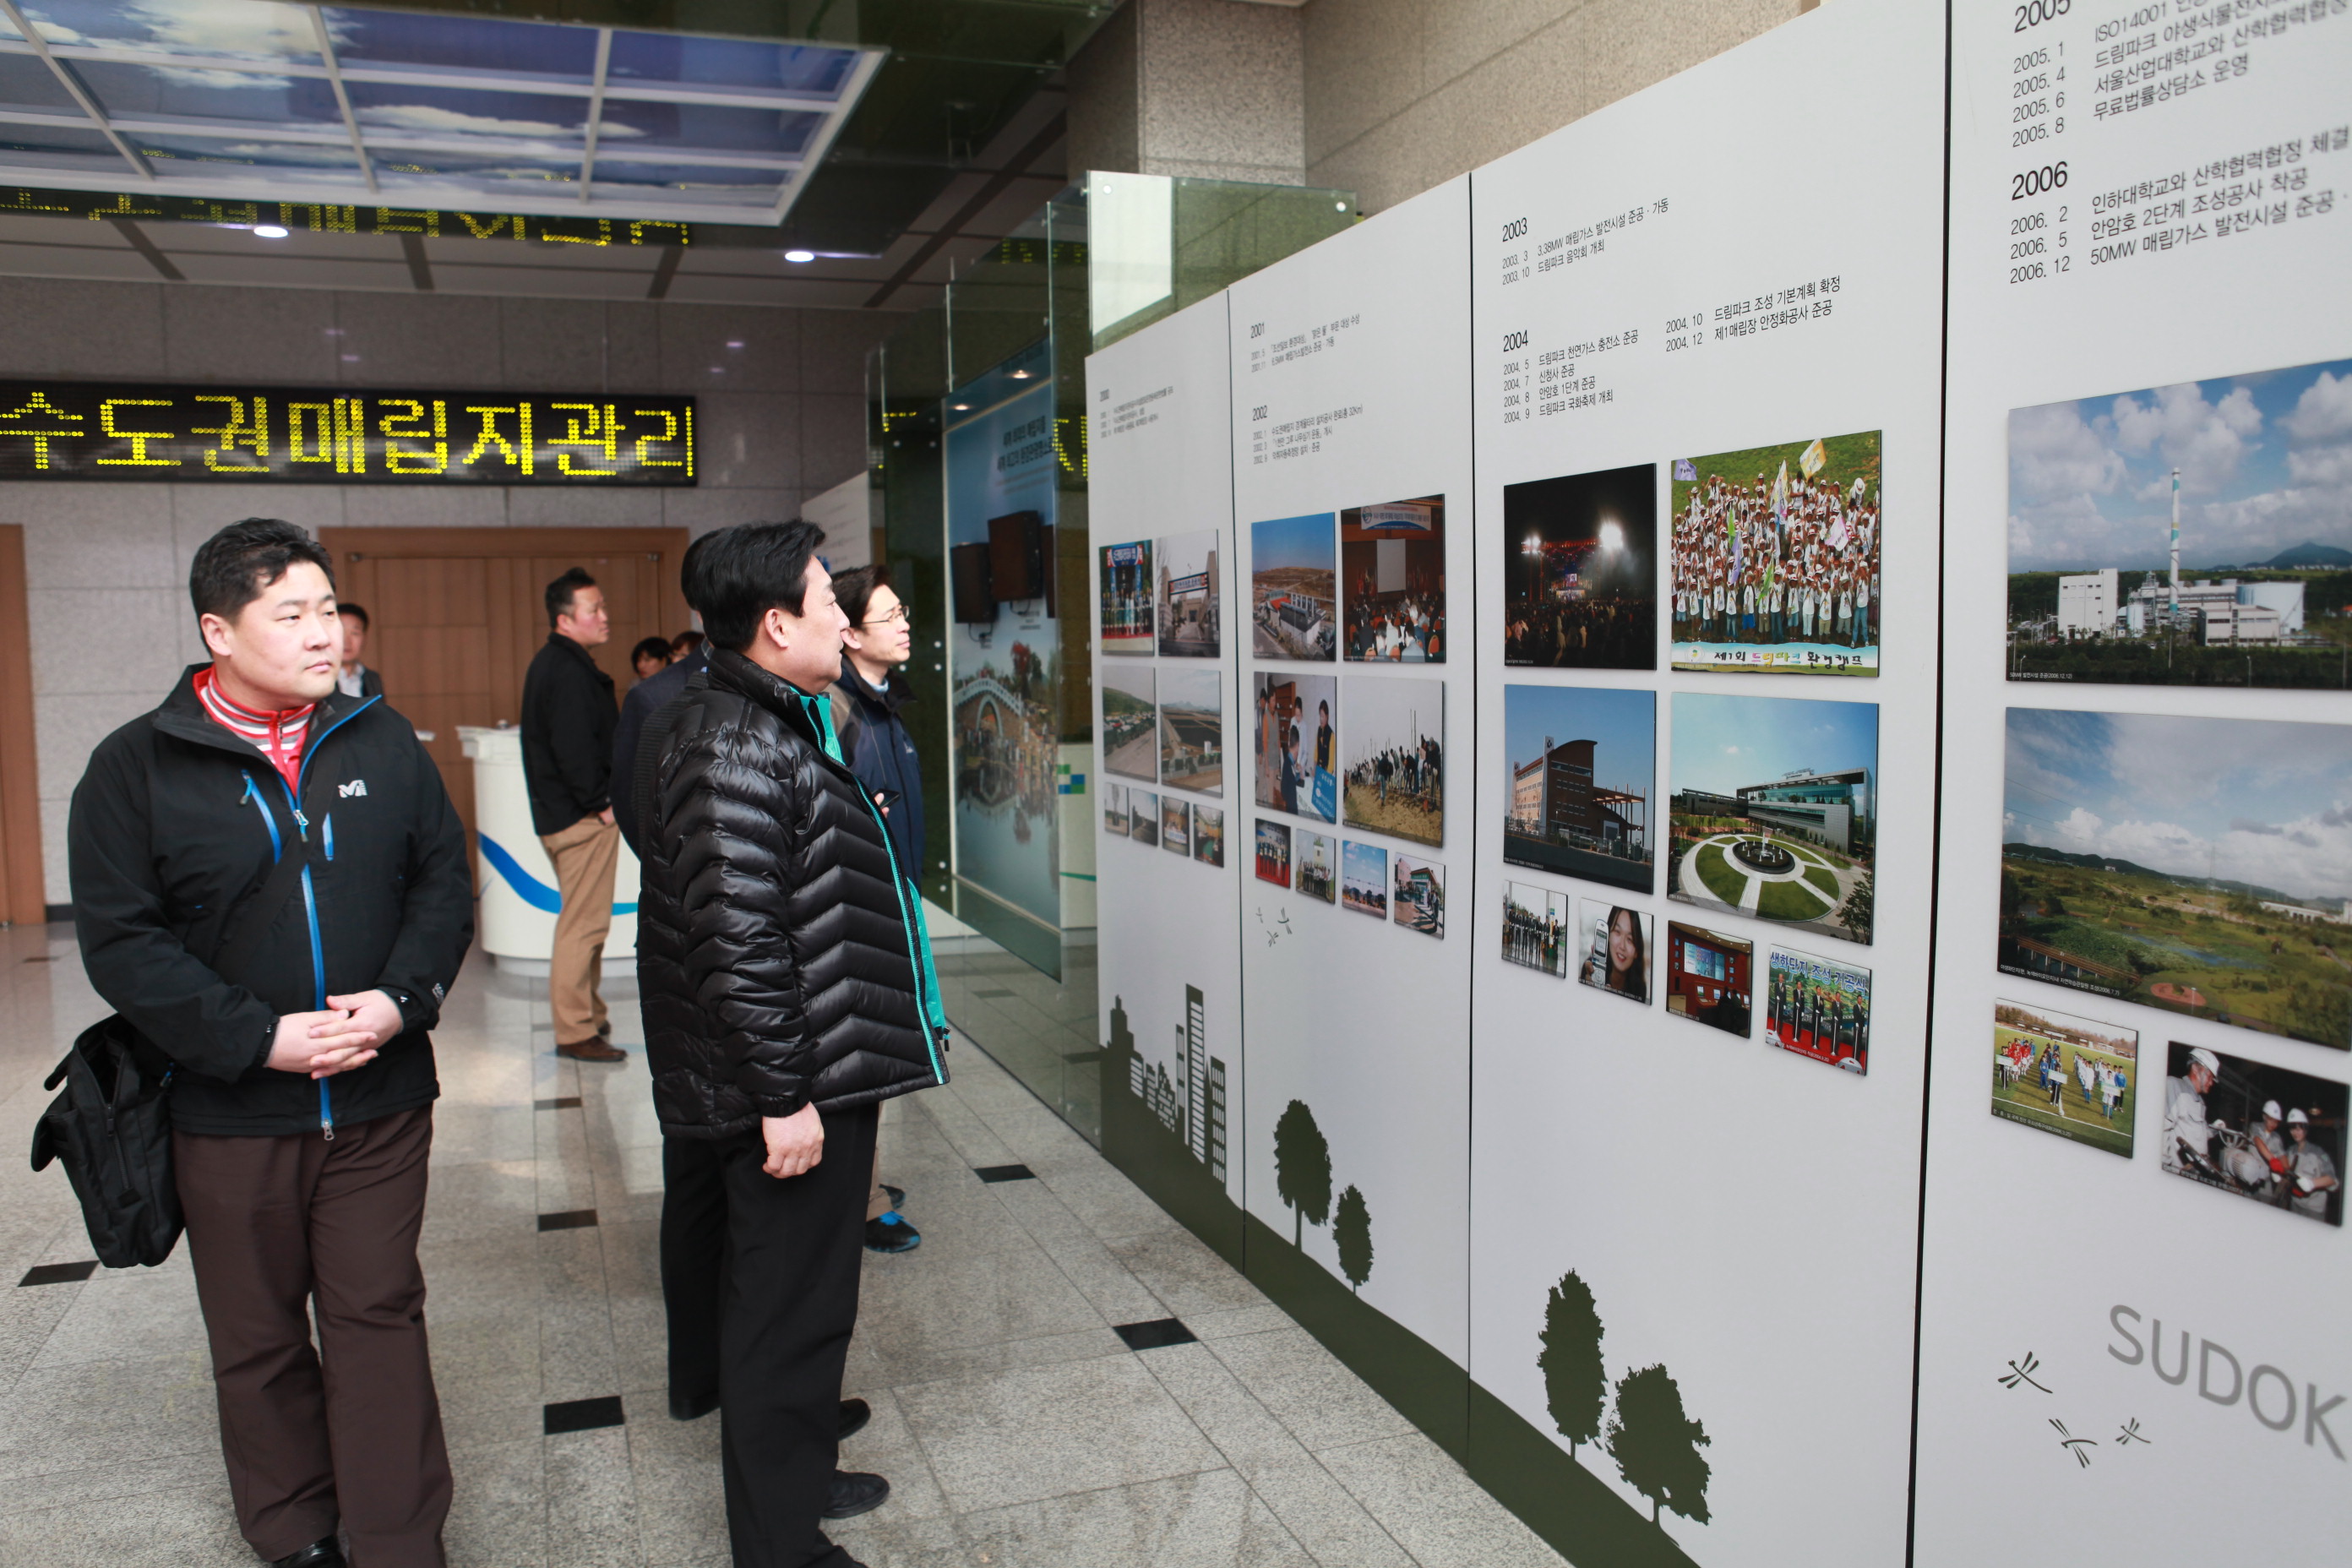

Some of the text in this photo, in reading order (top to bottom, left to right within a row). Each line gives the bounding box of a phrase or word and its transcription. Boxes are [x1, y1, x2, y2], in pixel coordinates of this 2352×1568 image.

[2014, 47, 2050, 74] 2005.
[2059, 41, 2064, 57] 1
[2095, 3, 2167, 42] ISO14001
[2013, 74, 2050, 99] 2005.
[2056, 67, 2065, 82] 4
[2094, 33, 2158, 68] 드림파크
[2013, 99, 2050, 122] 2005.
[2055, 92, 2065, 107] 6
[2094, 34, 2225, 94] 서울산업대학교와
[2012, 52, 2248, 148] 2005. 8 무료법률상담소 운영
[2011, 125, 2350, 236] 2006. 2 인하대학교와 산학협력협정 체결
[2012, 161, 2068, 200] 2006
[1502, 217, 1527, 242] 2003
[1502, 198, 1669, 270] 2003. 3 3.38MW 매립가스 발전시설 준공 가동
[2011, 166, 2308, 260] 2006. 5 안암호 2단계 조성공사 착공
[2011, 188, 2335, 284] 2006. 12 50MW 매립가스 발전시설 준공
[1502, 239, 1605, 286] 2003. 10 드림파크 음악회 개최
[1250, 322, 1265, 339] 2001
[1666, 275, 1841, 334] 2004. 10 드림파크 조성 기본계획 확정
[1666, 299, 1832, 352] 2004. 12 제1매립장 안정화공사 준공
[1503, 329, 1528, 352] 2004
[1504, 329, 1639, 375] 2004. 5 드림파크 천연가스 충전소 준공
[1504, 363, 1575, 391] 2004. 7 신청사 준공
[1504, 376, 1596, 408] 2004. 8 안암호 1단계 준공
[1252, 406, 1267, 422] 2002
[1505, 389, 1614, 423] 2004. 9 드림파크 국화축제 개최
[0, 391, 694, 478] 수도권매립지관리
[1811, 964, 1832, 985] 조성
[2108, 1304, 2348, 1462] SUDOK
